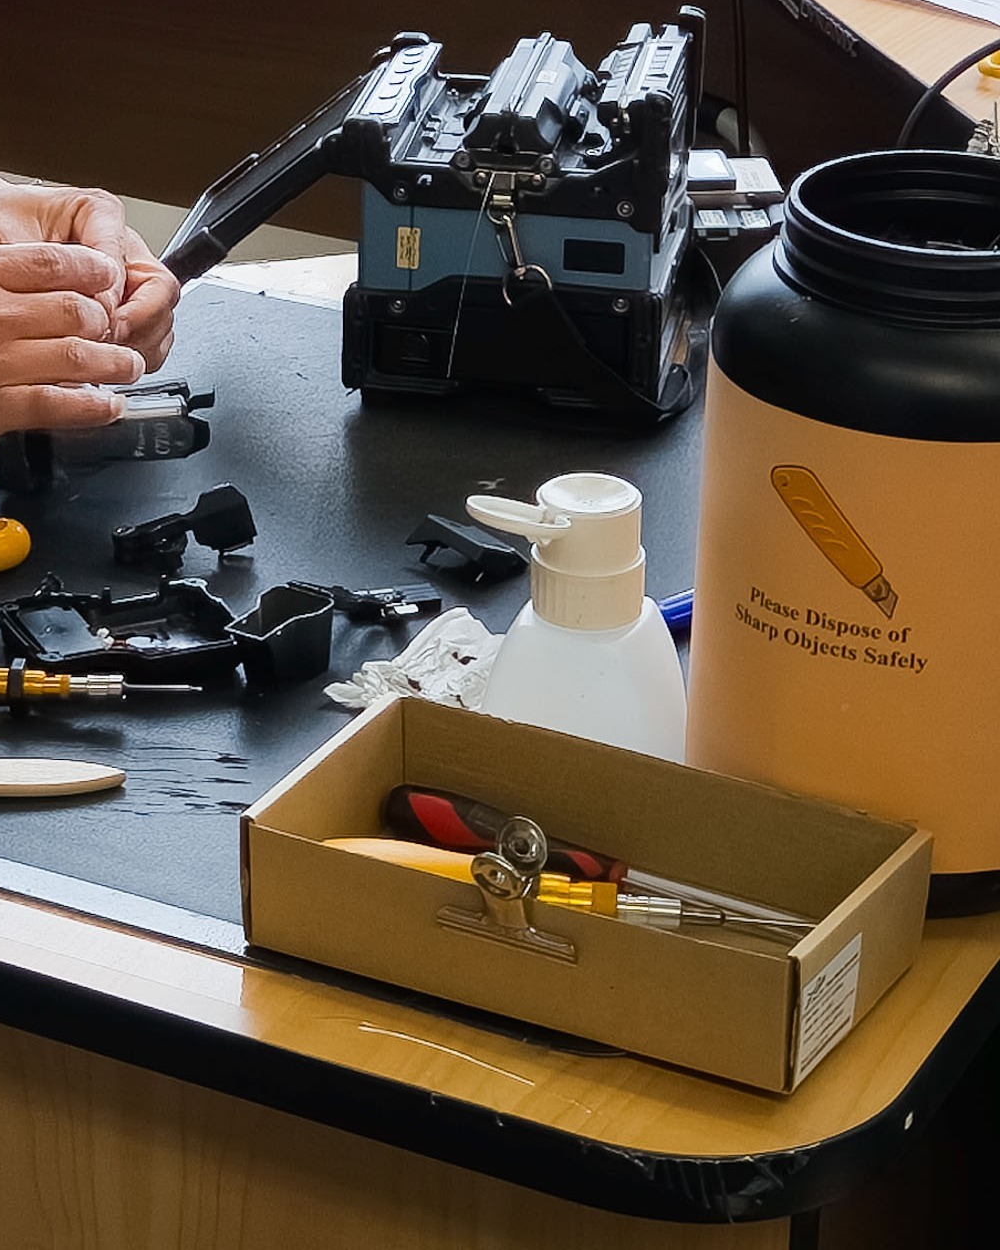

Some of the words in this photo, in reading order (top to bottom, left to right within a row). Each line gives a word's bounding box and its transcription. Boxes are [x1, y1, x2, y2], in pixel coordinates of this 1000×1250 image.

[735, 603, 779, 642] Sharp
[784, 627, 857, 662] Objects
[863, 646, 929, 674] Safely
[750, 586, 799, 621] Please
[805, 608, 882, 640] Dispose
[887, 627, 912, 644] of
